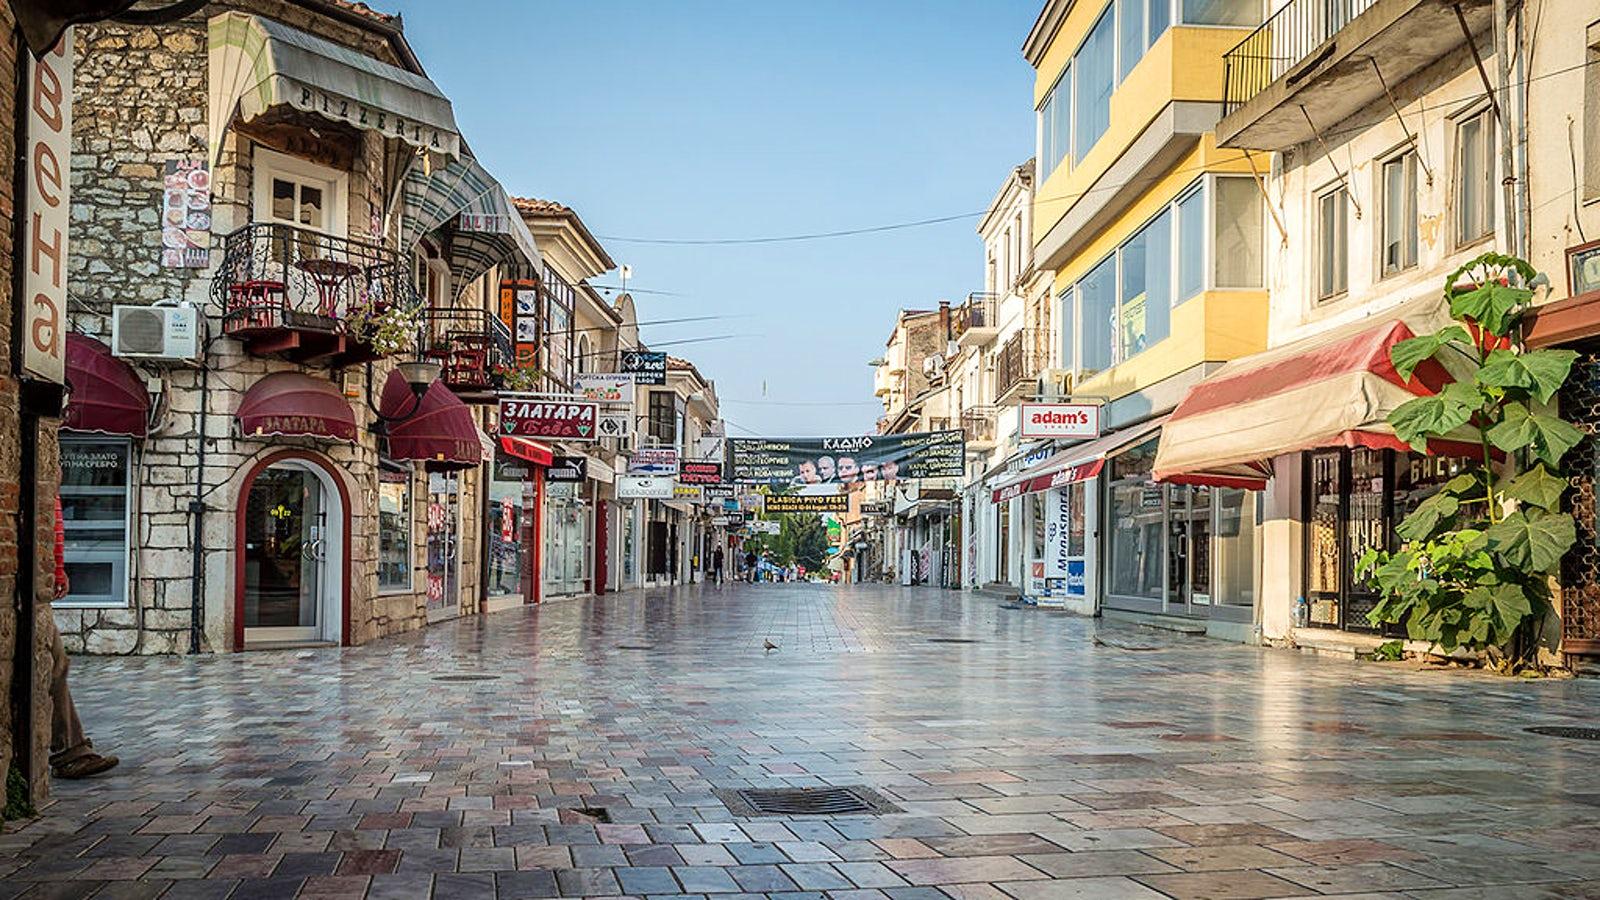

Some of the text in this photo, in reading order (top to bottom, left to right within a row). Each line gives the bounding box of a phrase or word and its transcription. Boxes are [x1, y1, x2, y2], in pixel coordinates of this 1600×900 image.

[301, 87, 440, 148] PIZZERIA
[504, 402, 593, 421] ЗЛАТАРА
[1032, 410, 1088, 424] adam's
